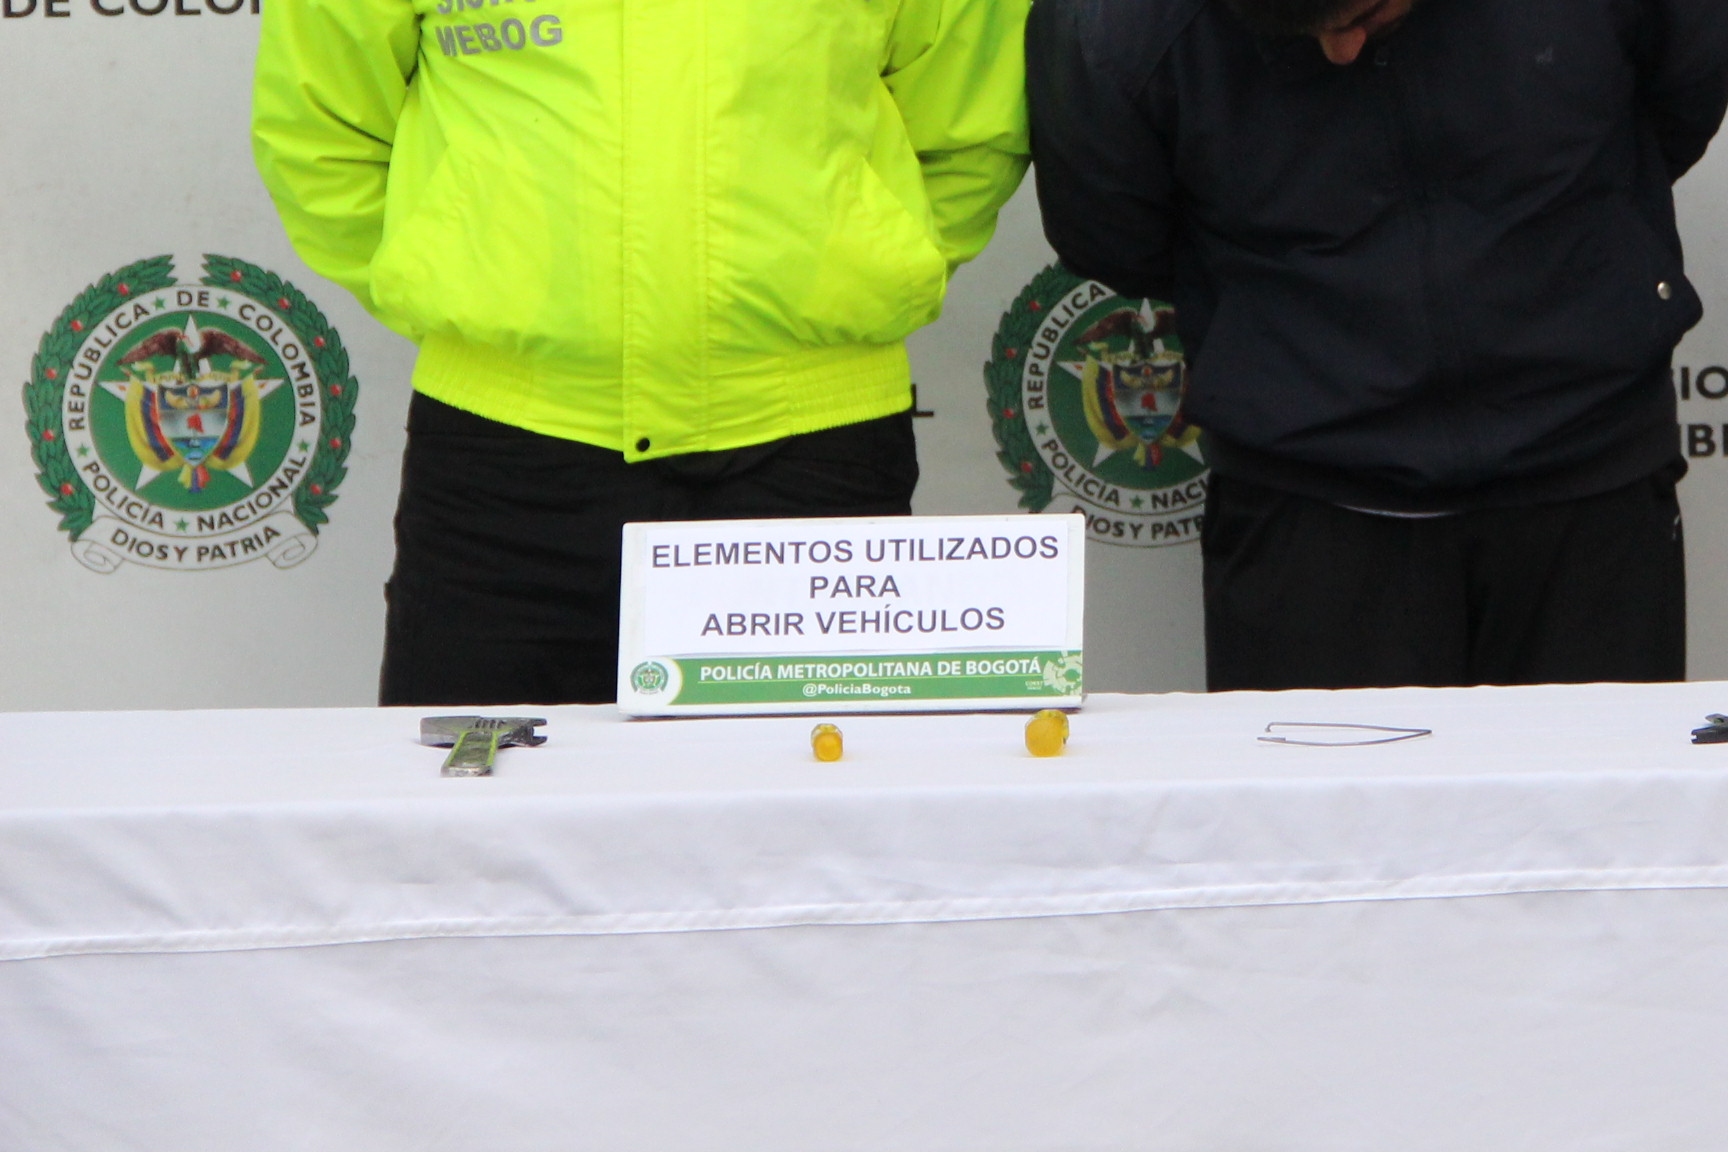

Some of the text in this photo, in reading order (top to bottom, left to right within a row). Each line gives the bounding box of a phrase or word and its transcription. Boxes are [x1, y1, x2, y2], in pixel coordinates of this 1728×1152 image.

[176, 290, 210, 308] DE
[238, 304, 315, 427] COLOMBIA
[198, 456, 306, 531] NACIONAL
[197, 525, 280, 562] PATRIA
[652, 535, 1059, 568] ELEMENTOS UTILIZADOS
[809, 574, 901, 599] PARA
[701, 603, 1005, 637] ABRIR VEHÍCULOS
[700, 654, 1042, 682] POLICÍA METROPOLITANA DE BOGOTÁ
[802, 682, 912, 697] @PoliciaBogota
